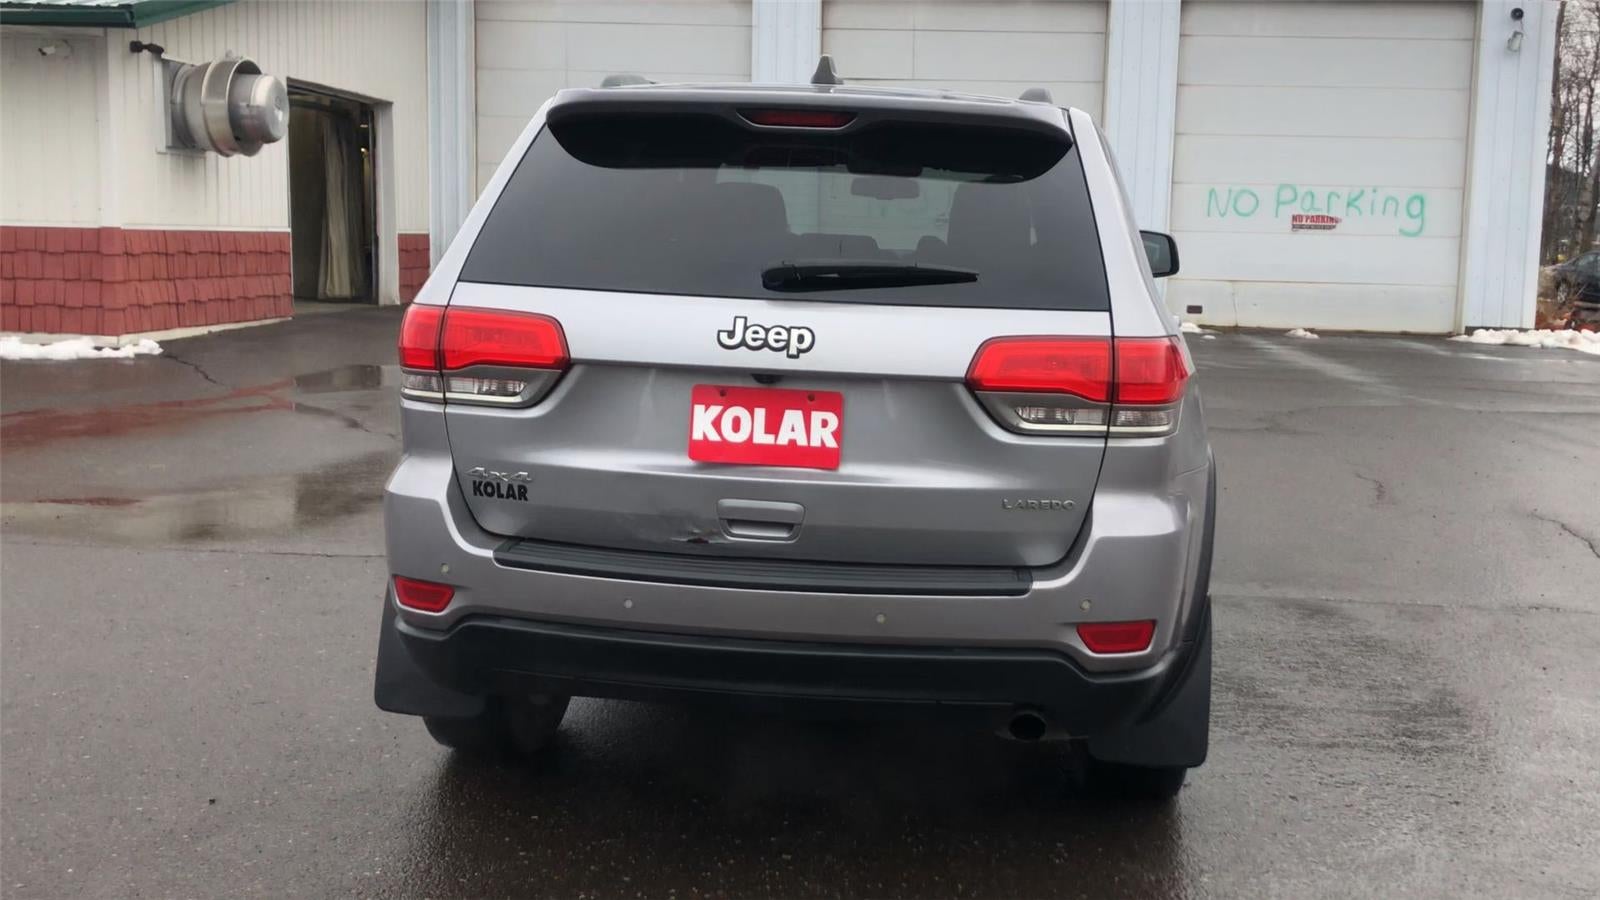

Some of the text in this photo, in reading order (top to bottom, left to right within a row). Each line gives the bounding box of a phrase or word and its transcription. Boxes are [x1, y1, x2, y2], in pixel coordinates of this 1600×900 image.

[1207, 188, 1259, 217] NO
[1292, 214, 1304, 223] NO
[717, 316, 815, 359] Jeep
[692, 404, 839, 448] KOLAR
[472, 480, 528, 501] KOLAR
[1002, 498, 1075, 510] LAREDO
